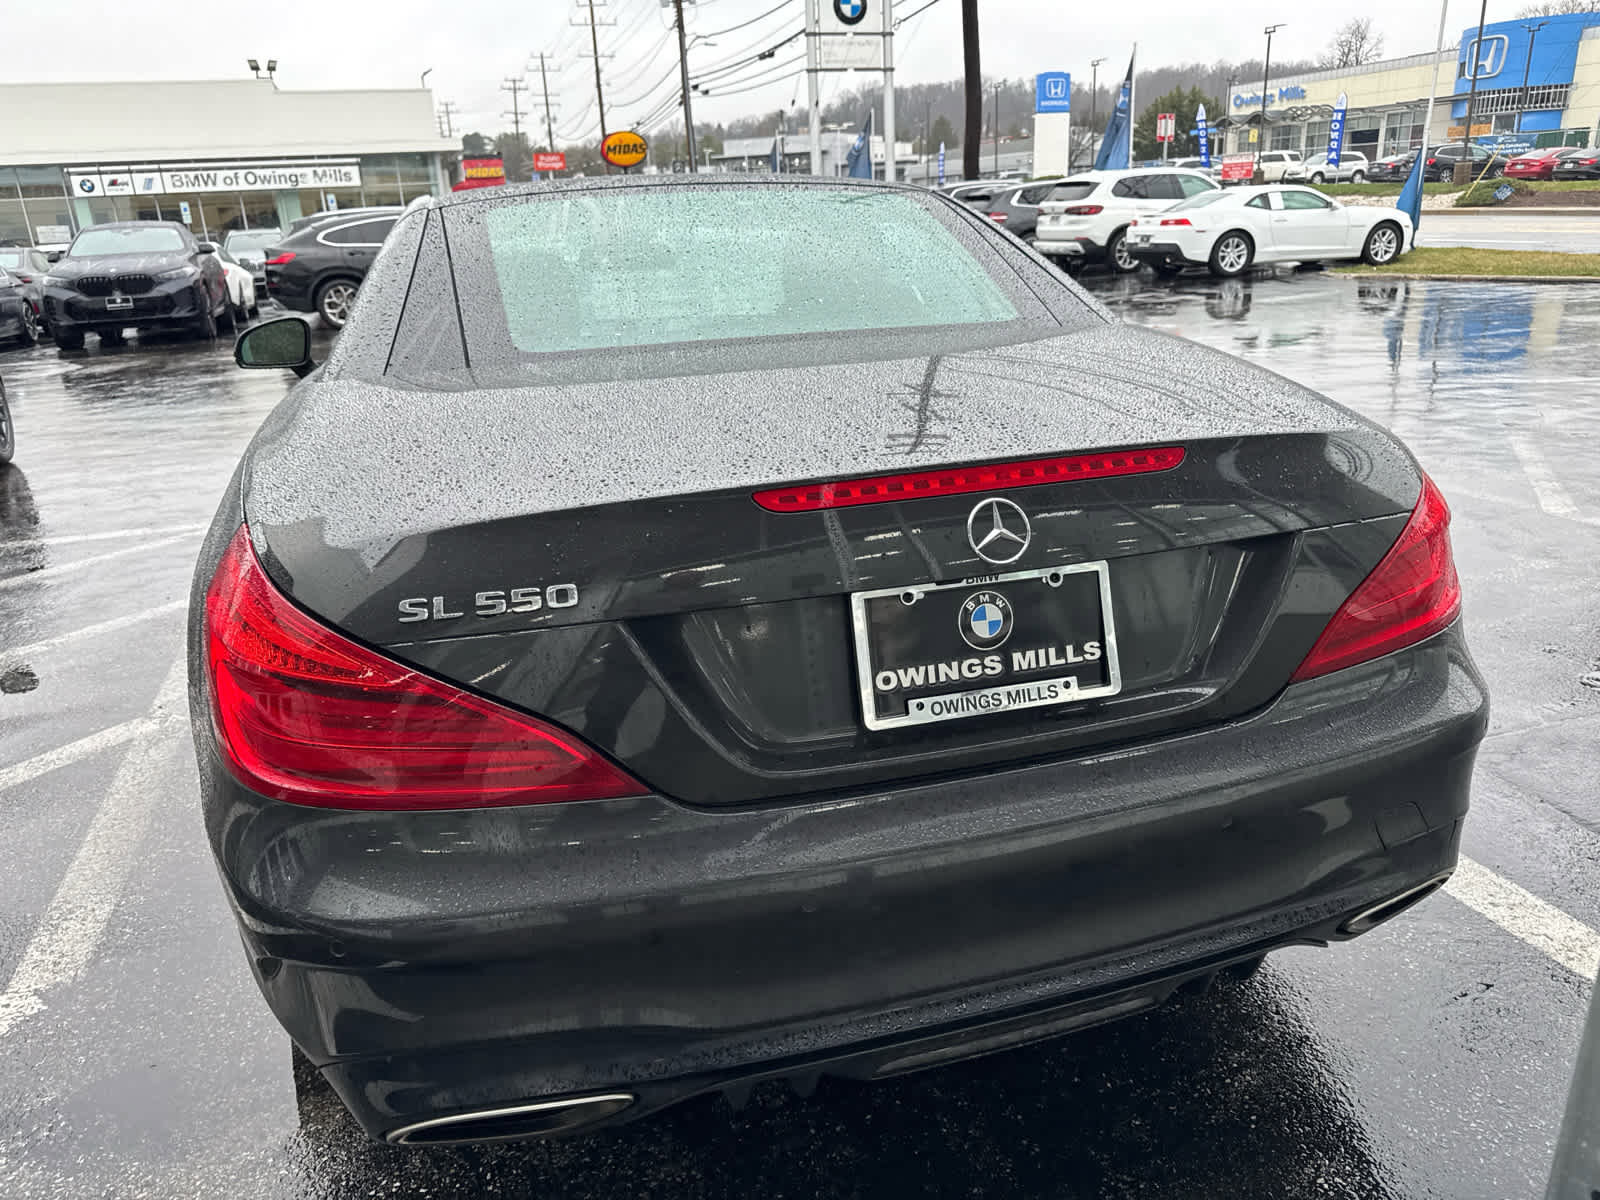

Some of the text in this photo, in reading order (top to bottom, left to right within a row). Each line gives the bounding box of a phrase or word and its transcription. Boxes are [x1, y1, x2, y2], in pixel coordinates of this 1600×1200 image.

[605, 142, 647, 155] MIDAS
[170, 168, 353, 188] BMW of Owings Mills
[466, 167, 504, 179] MIDAS
[398, 583, 578, 623] SL 550
[875, 641, 1101, 691] OWINGS MILLS
[930, 684, 1059, 716] OWINGS MILLS
